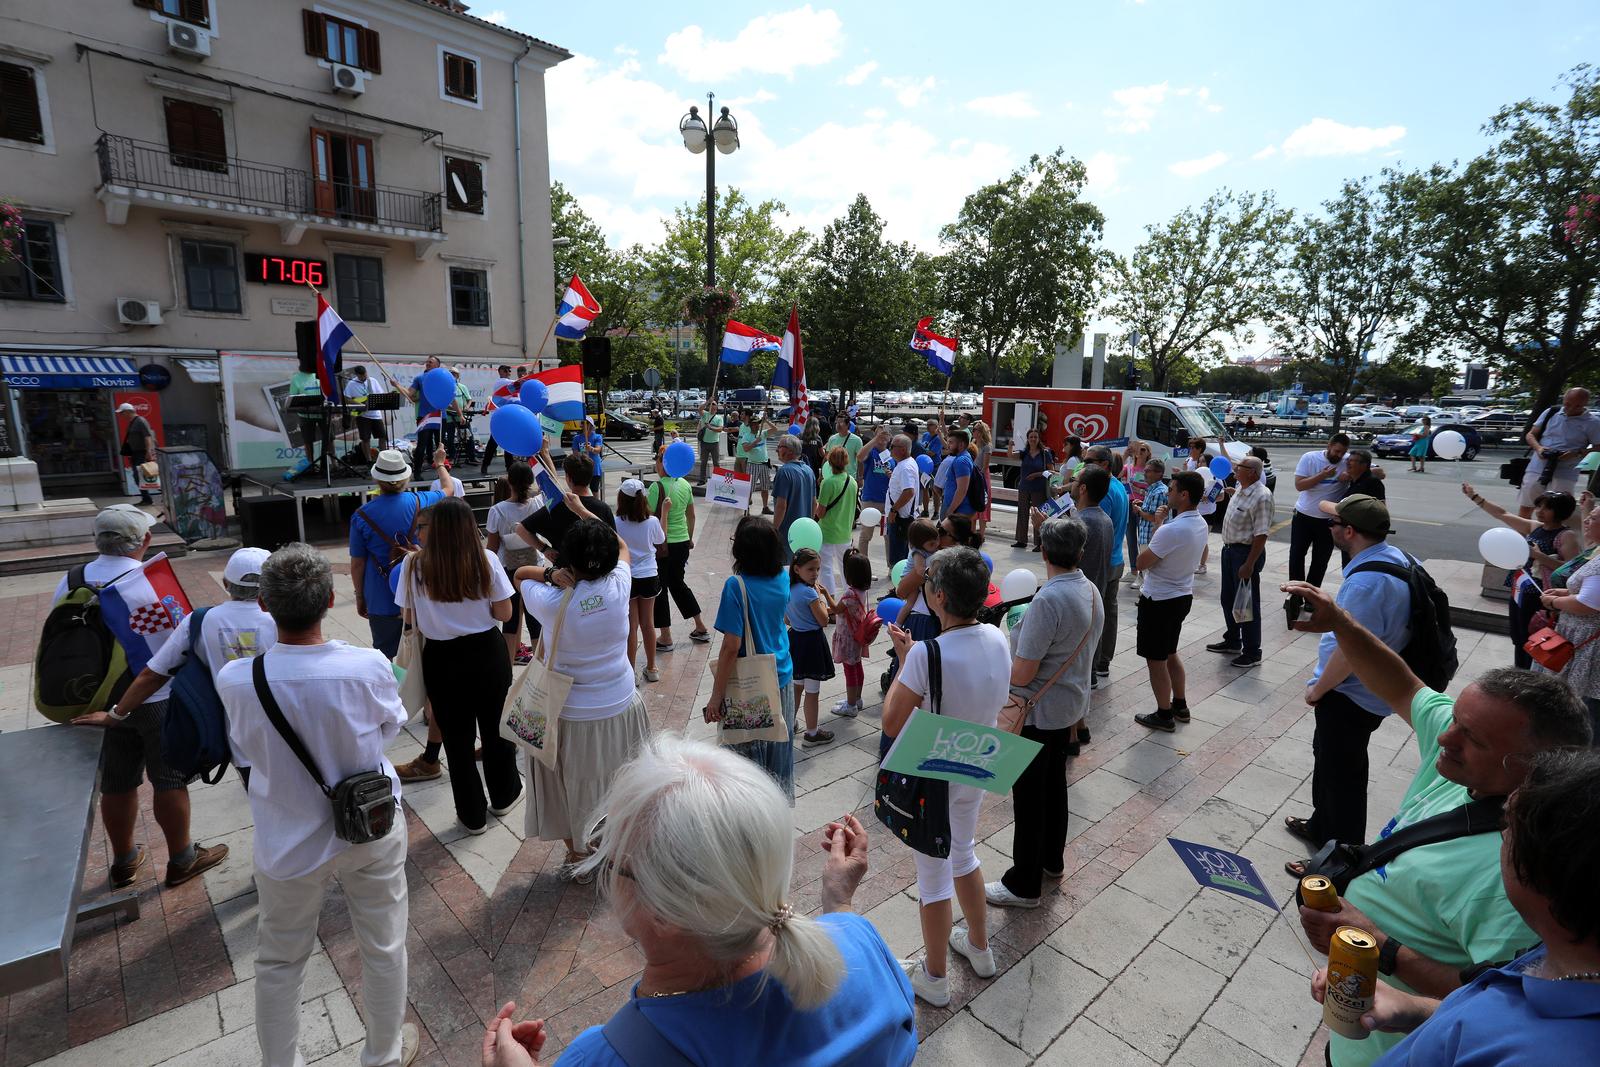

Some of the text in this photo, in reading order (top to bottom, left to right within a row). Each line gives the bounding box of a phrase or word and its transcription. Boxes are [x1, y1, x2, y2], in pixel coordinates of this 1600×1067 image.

[276, 448, 307, 459] 202
[933, 727, 1001, 758] HOD
[1186, 847, 1241, 875] HOD
[1328, 984, 1365, 1007] Kozel
